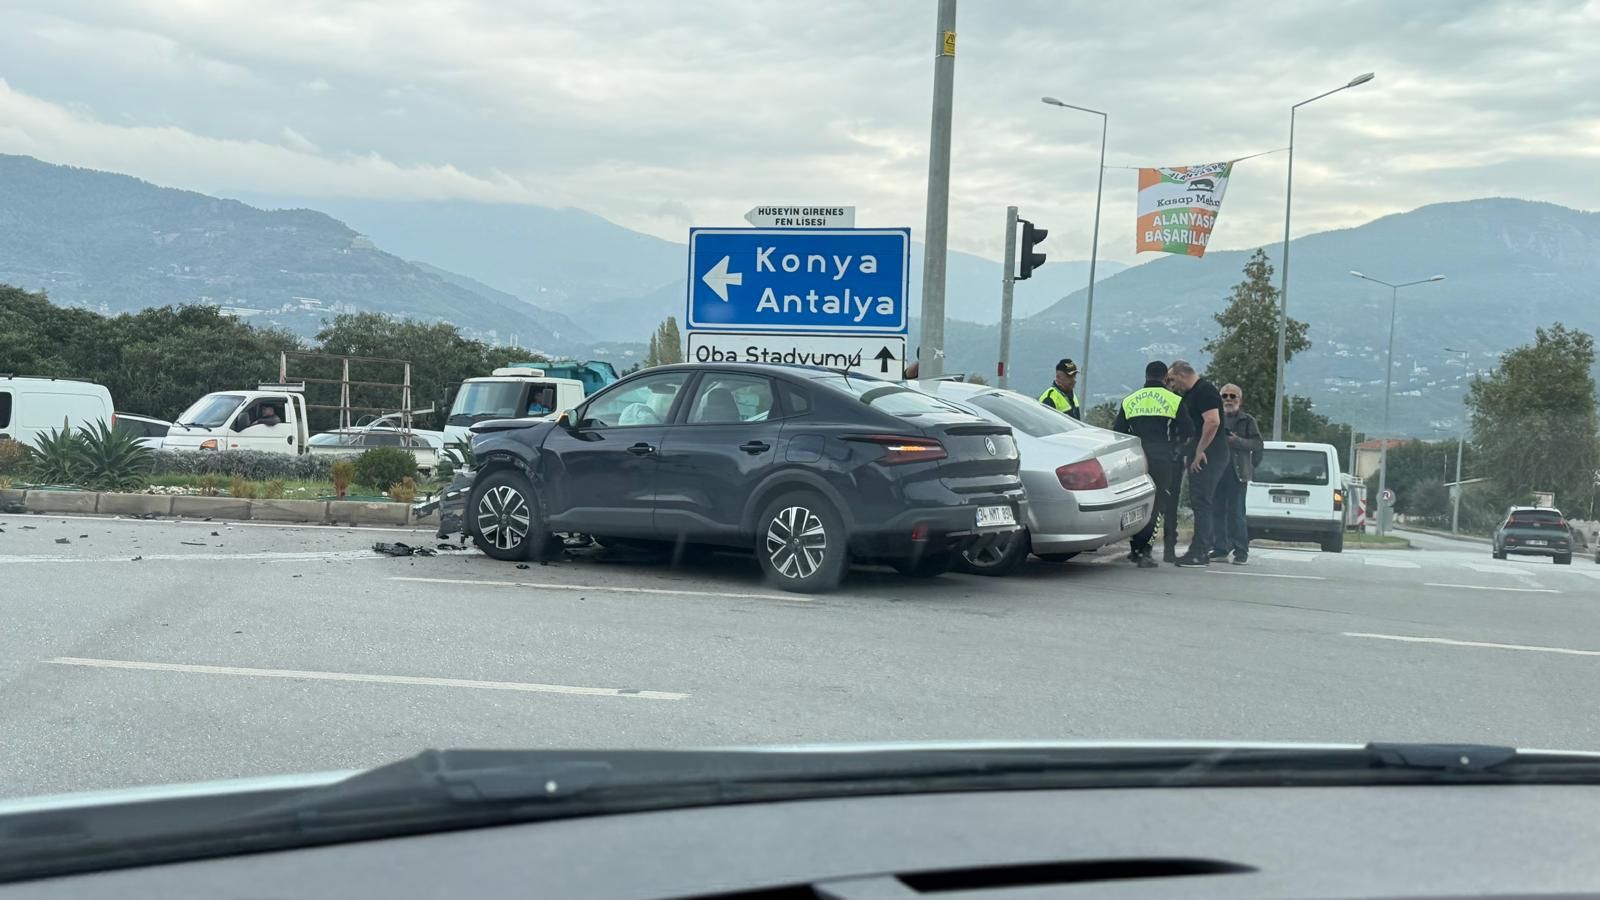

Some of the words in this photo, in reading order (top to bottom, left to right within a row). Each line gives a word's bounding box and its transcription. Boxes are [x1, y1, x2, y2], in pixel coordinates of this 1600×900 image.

[1157, 195, 1193, 207] Kasap
[758, 206, 800, 216] HÜSEYİN
[775, 218, 793, 226] FEN
[796, 217, 826, 226] LİSESİ
[756, 247, 877, 280] Konya
[755, 288, 894, 322] Antalya
[696, 345, 737, 363] Oba
[978, 508, 987, 521] 34
